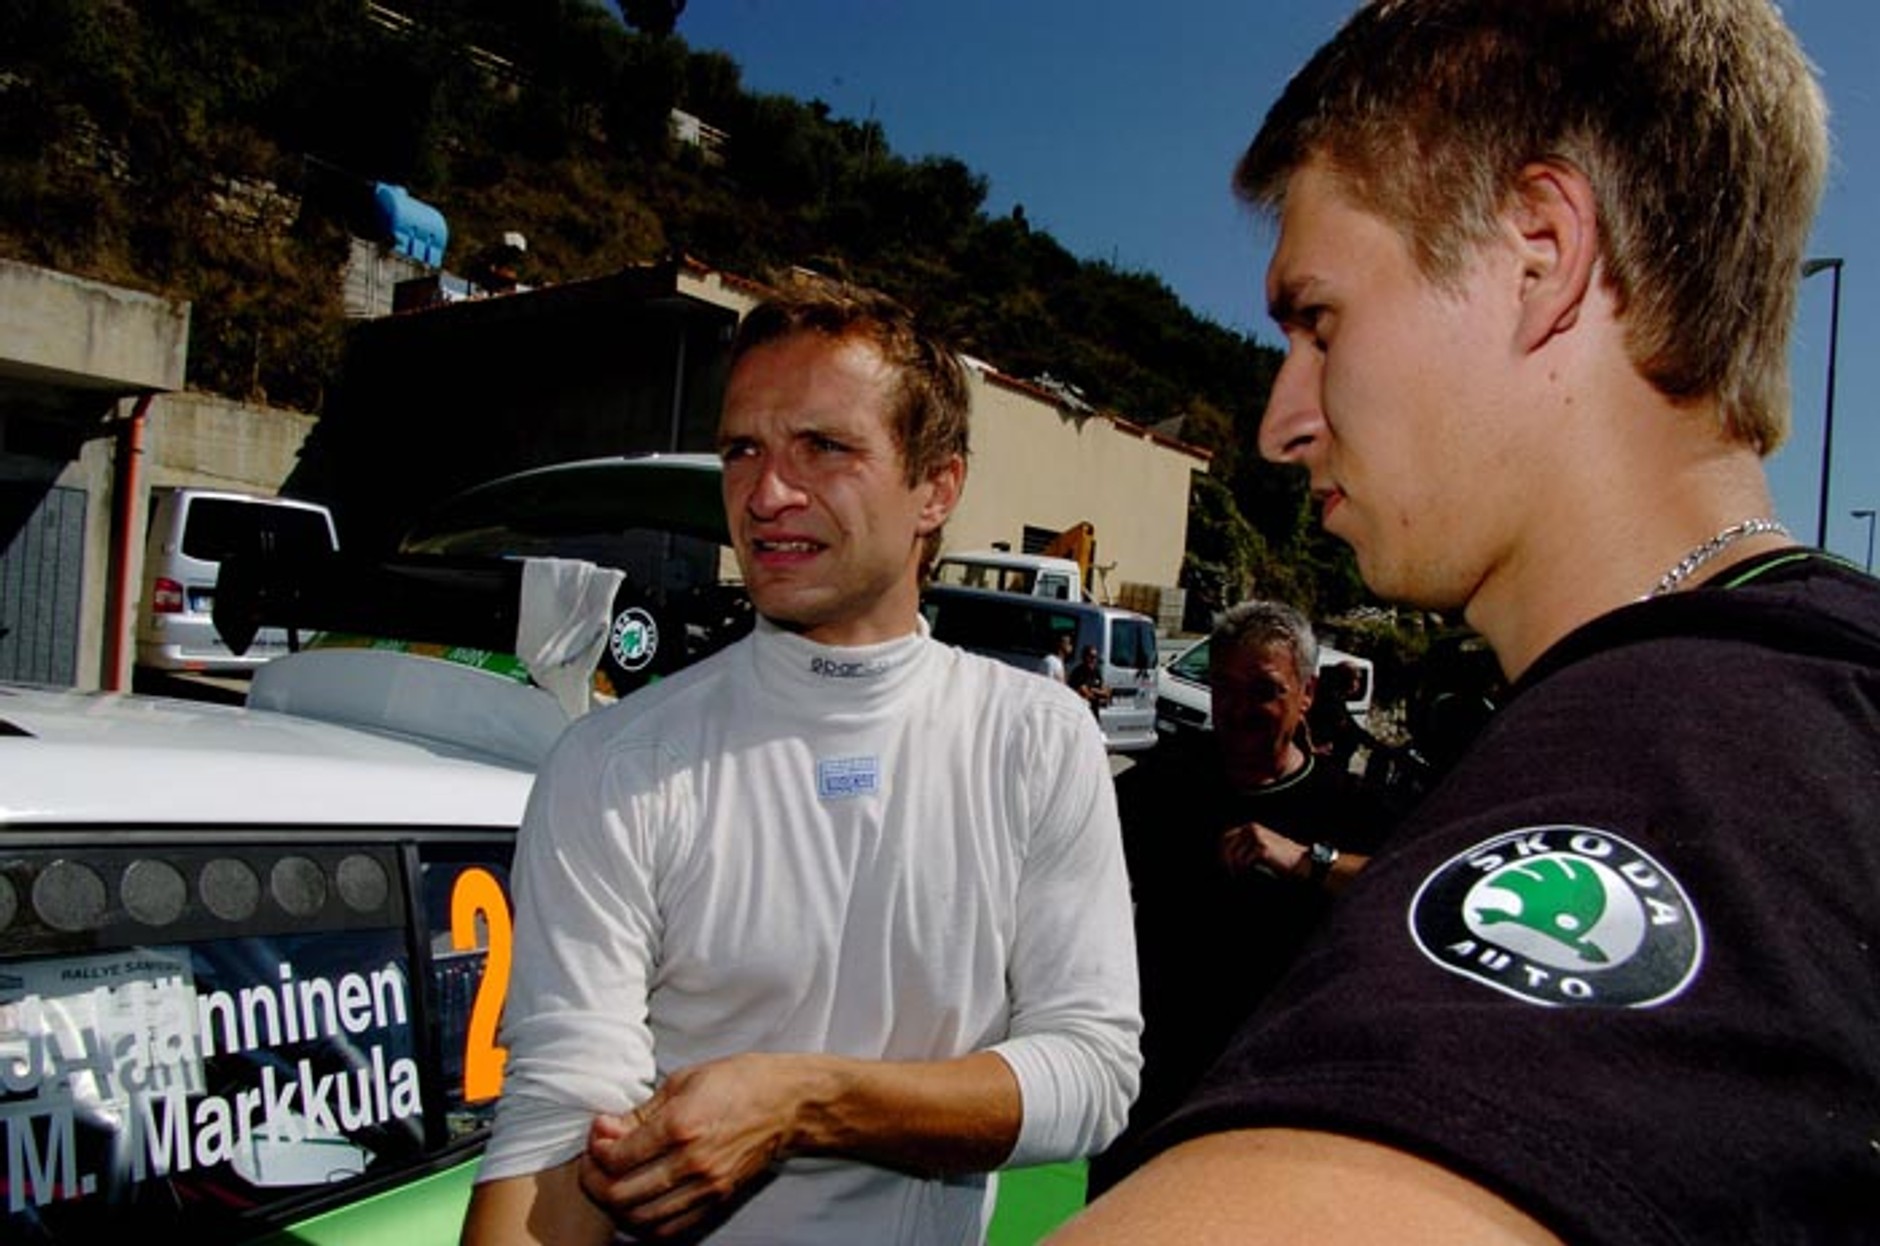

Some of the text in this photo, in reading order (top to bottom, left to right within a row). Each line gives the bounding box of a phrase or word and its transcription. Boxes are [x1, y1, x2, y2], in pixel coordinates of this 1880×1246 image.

[450, 867, 514, 1103] 2
[1448, 939, 1594, 998] AUTO
[6, 1045, 422, 1213] M. Markkula
